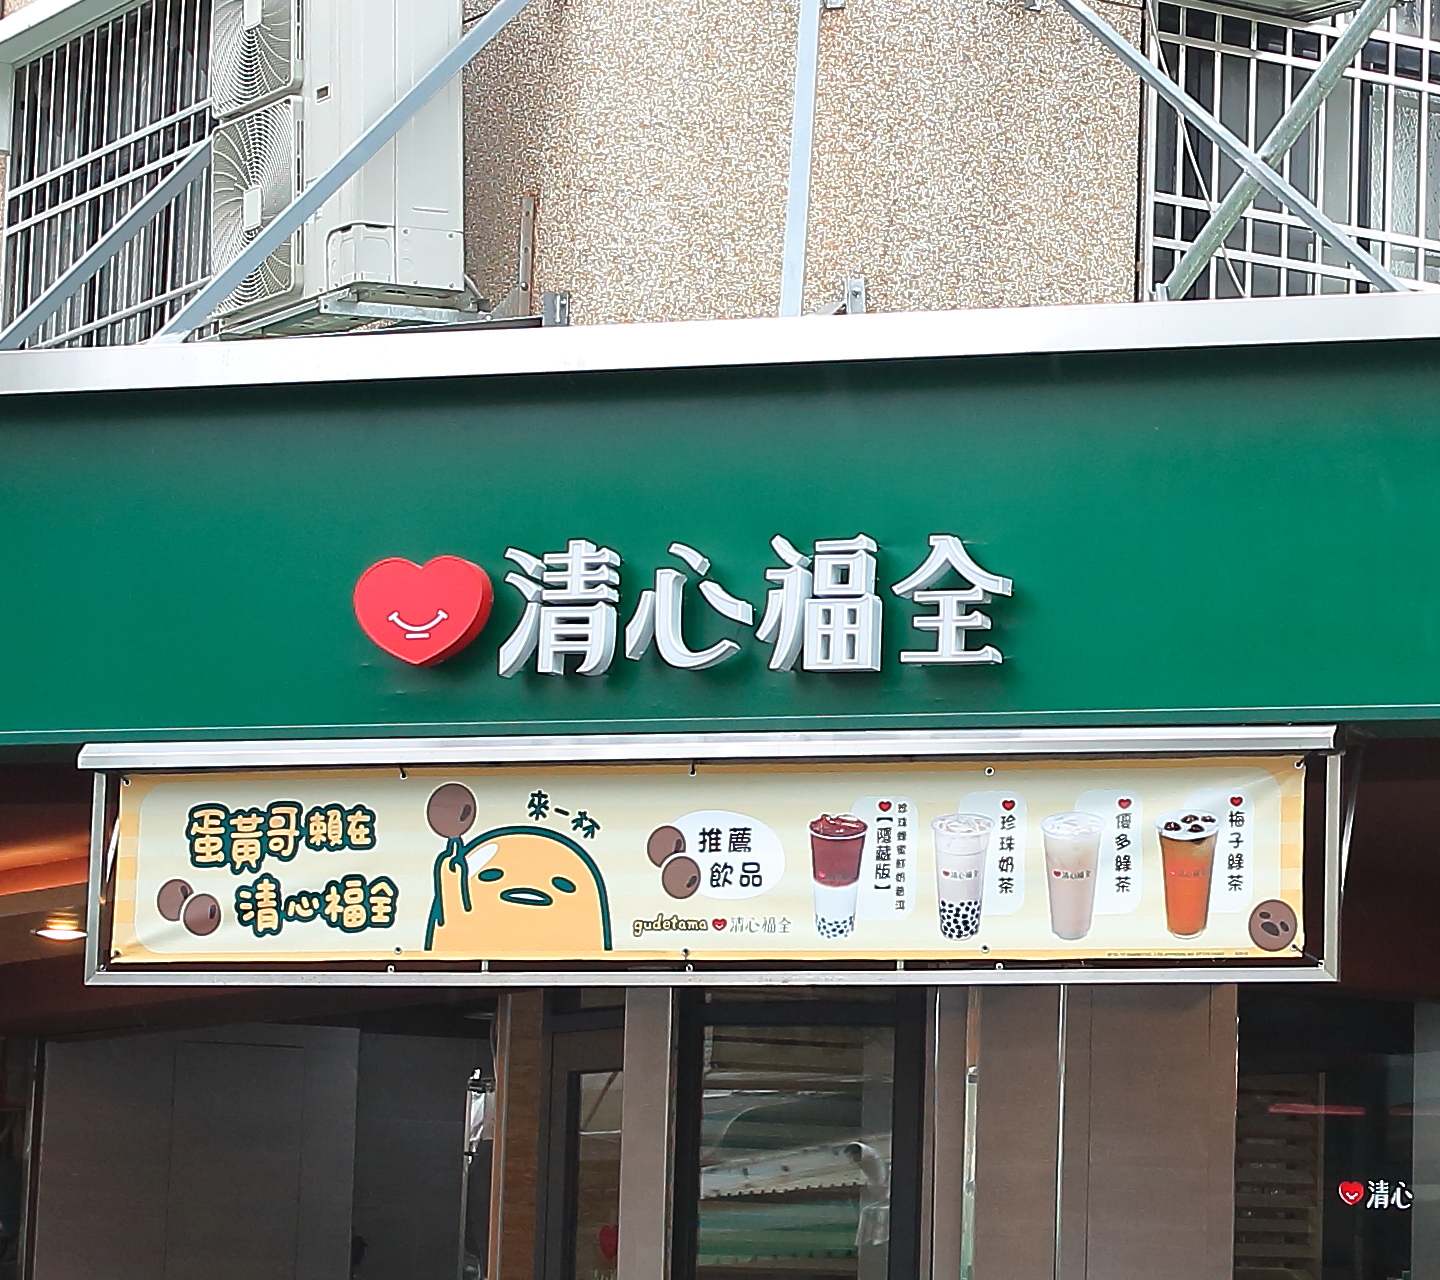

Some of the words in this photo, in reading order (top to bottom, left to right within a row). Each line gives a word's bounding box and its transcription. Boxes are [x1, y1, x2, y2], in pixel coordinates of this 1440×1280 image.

[497, 534, 1013, 678] 清心福全
[527, 789, 600, 839] 來一杯
[698, 827, 752, 853] 推薦
[998, 814, 1016, 894] 珍珠奶茶
[1228, 810, 1245, 891] 梅子綠茶
[710, 862, 762, 887] 飲品
[234, 874, 398, 936] 清心福全
[633, 913, 708, 937] gudetama
[730, 917, 791, 933] 清心福全
[1367, 1180, 1413, 1209] 清心
